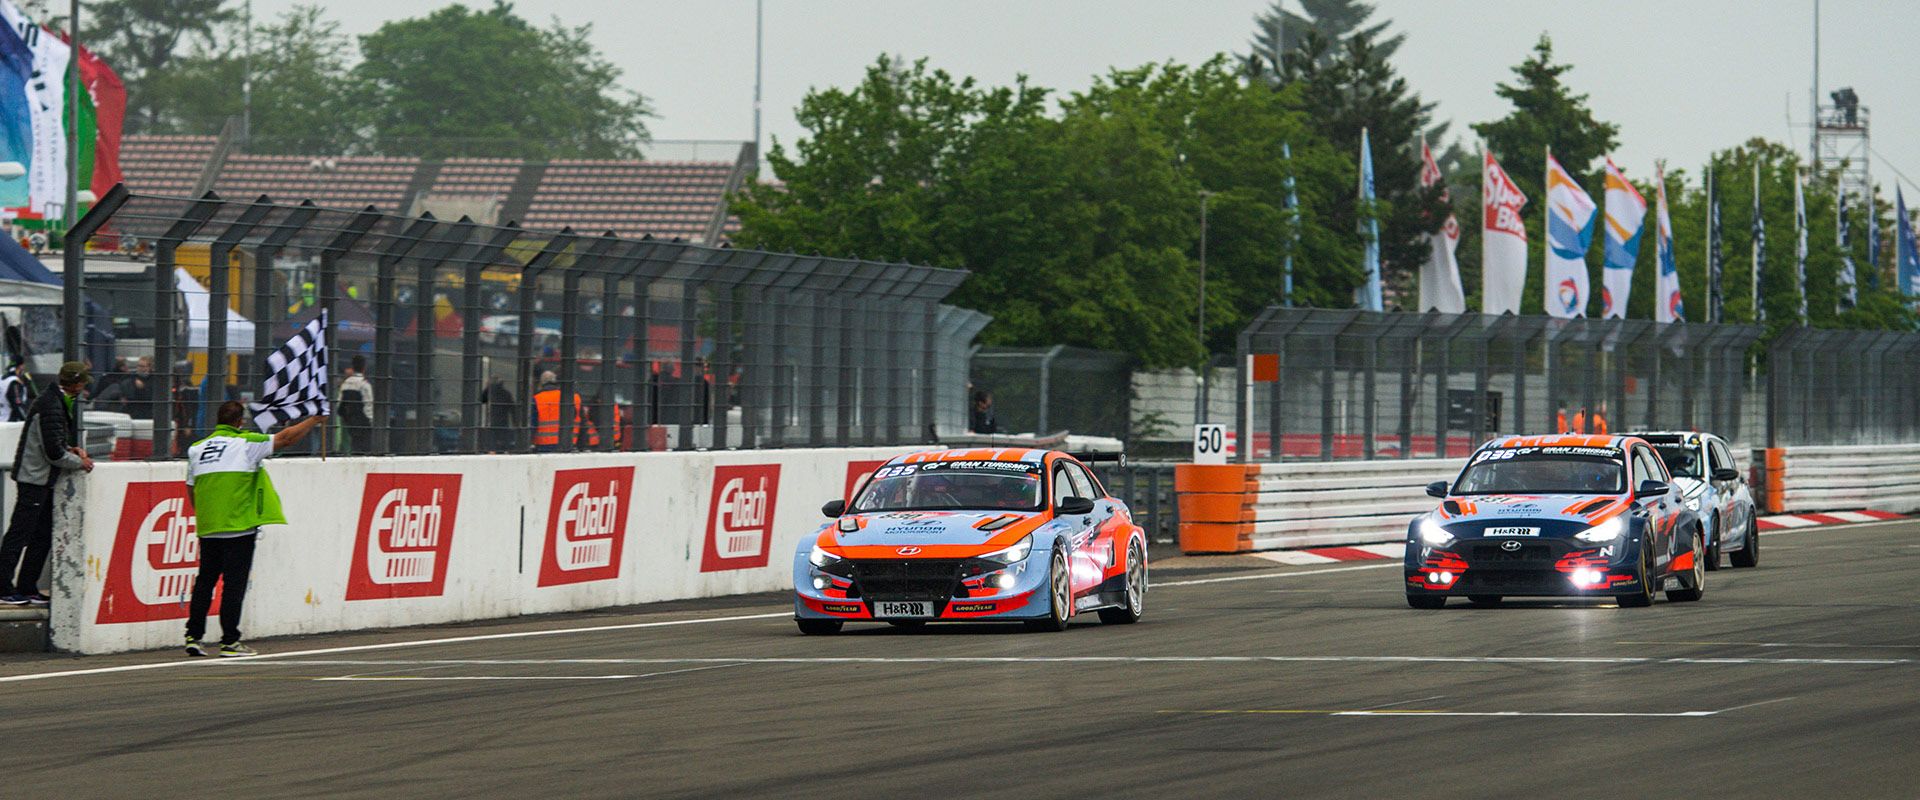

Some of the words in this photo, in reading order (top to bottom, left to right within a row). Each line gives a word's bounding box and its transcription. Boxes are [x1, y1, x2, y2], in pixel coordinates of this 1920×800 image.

[1199, 427, 1222, 453] 50
[200, 444, 228, 461] 24
[1571, 447, 1616, 456] TURISMO
[874, 465, 918, 479] 035
[982, 461, 1030, 470] TURISMO
[715, 476, 768, 559] Eibach
[555, 480, 618, 571] Eibach
[366, 488, 442, 585] Eibach
[131, 498, 200, 605] Eiba
[1421, 546, 1431, 557] N
[1599, 545, 1614, 557] N
[1016, 560, 1027, 575] N
[883, 602, 910, 615] H&R
